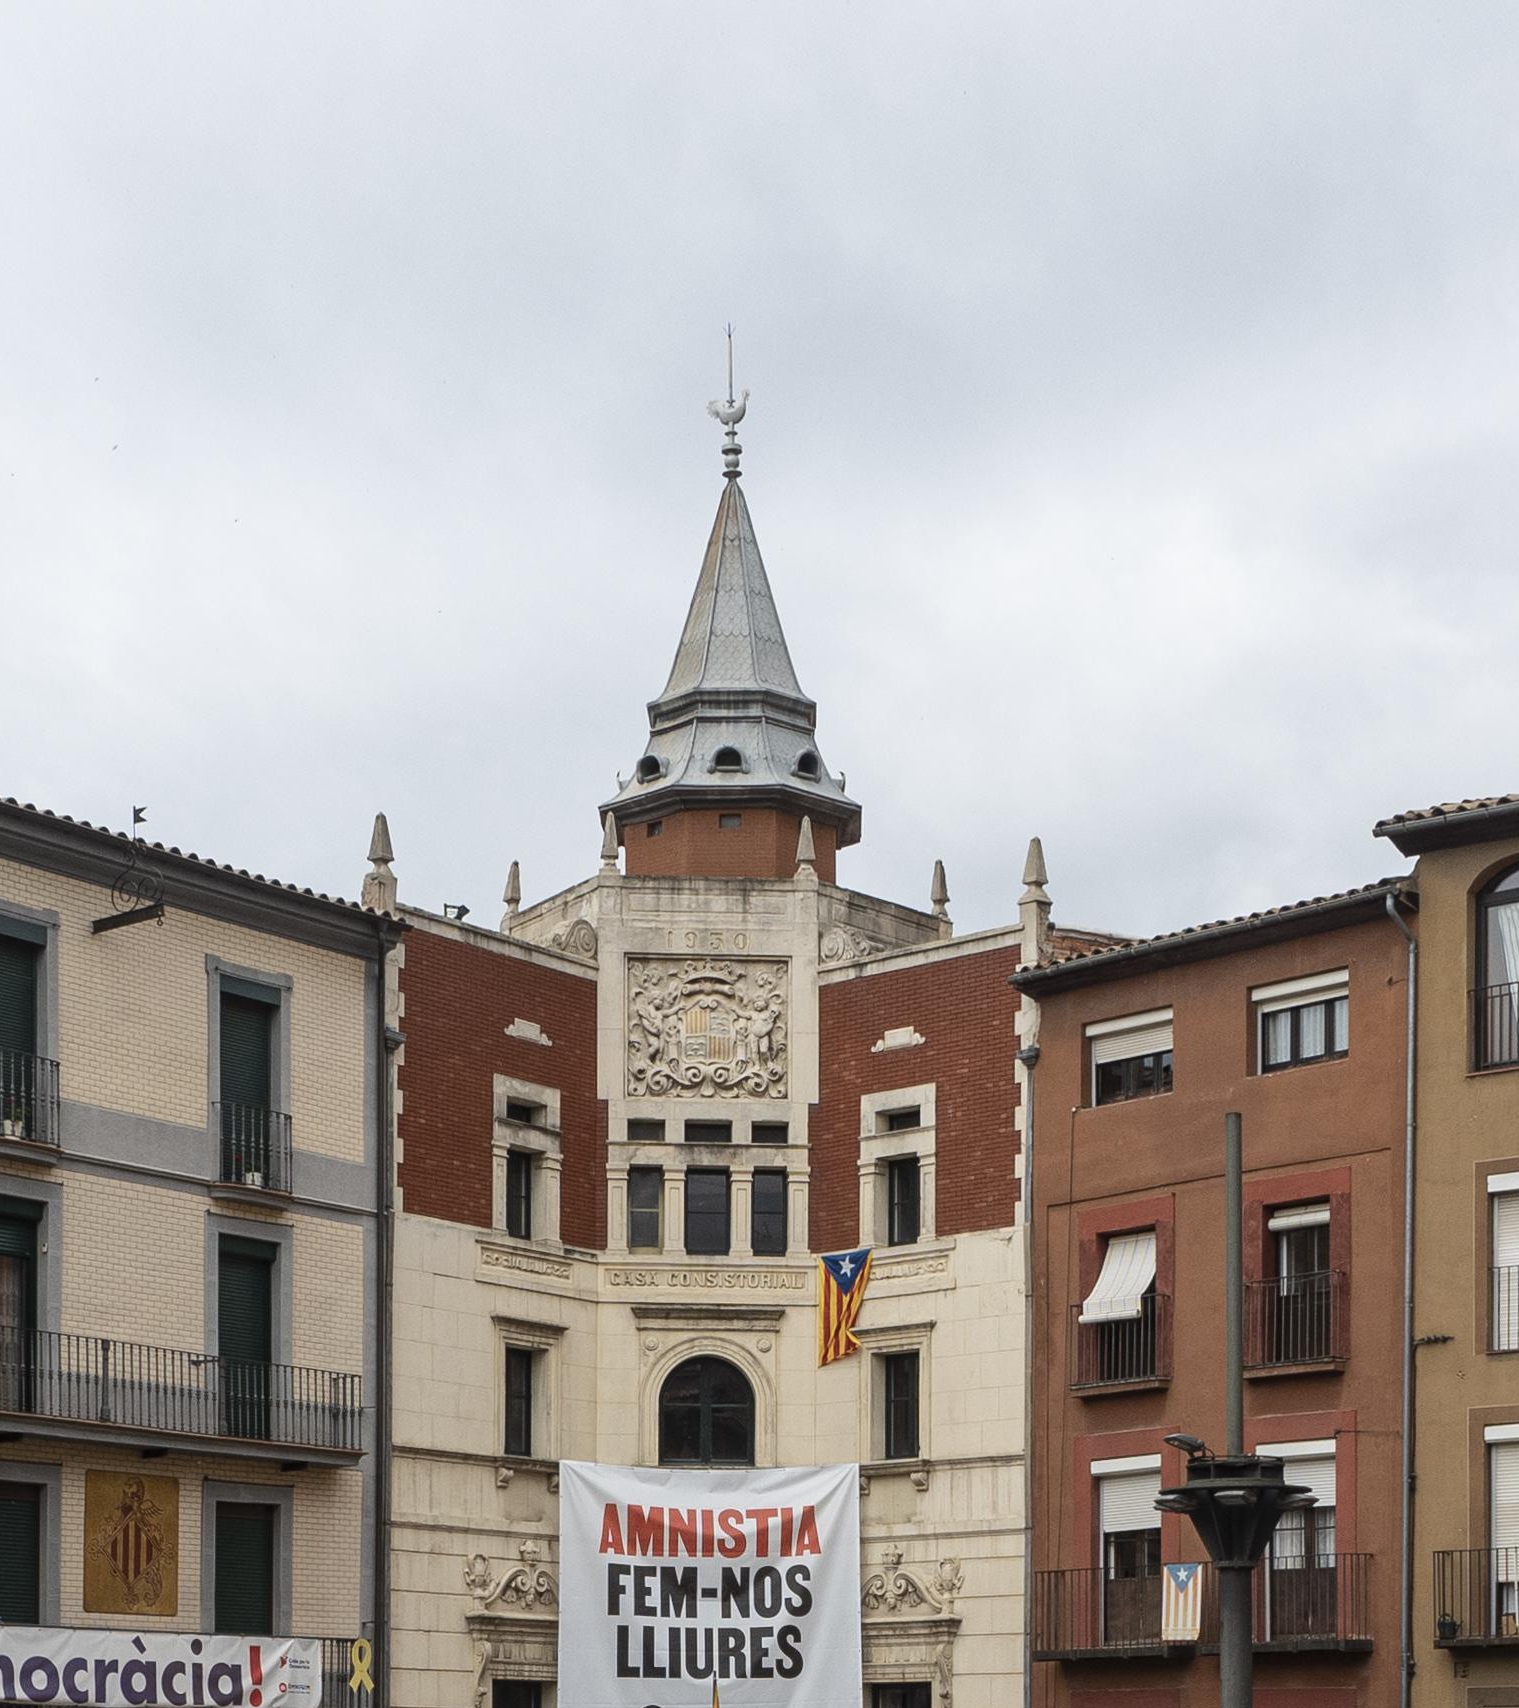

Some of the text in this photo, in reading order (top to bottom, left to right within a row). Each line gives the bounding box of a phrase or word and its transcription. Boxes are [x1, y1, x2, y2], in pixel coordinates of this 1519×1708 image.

[666, 931, 751, 950] 1930
[610, 1272, 804, 1290] CASA CONSISTORIAL
[599, 1503, 822, 1558] AMNISTIA
[607, 1563, 813, 1618] FEM-NOS
[616, 1624, 804, 1679] LLIURES
